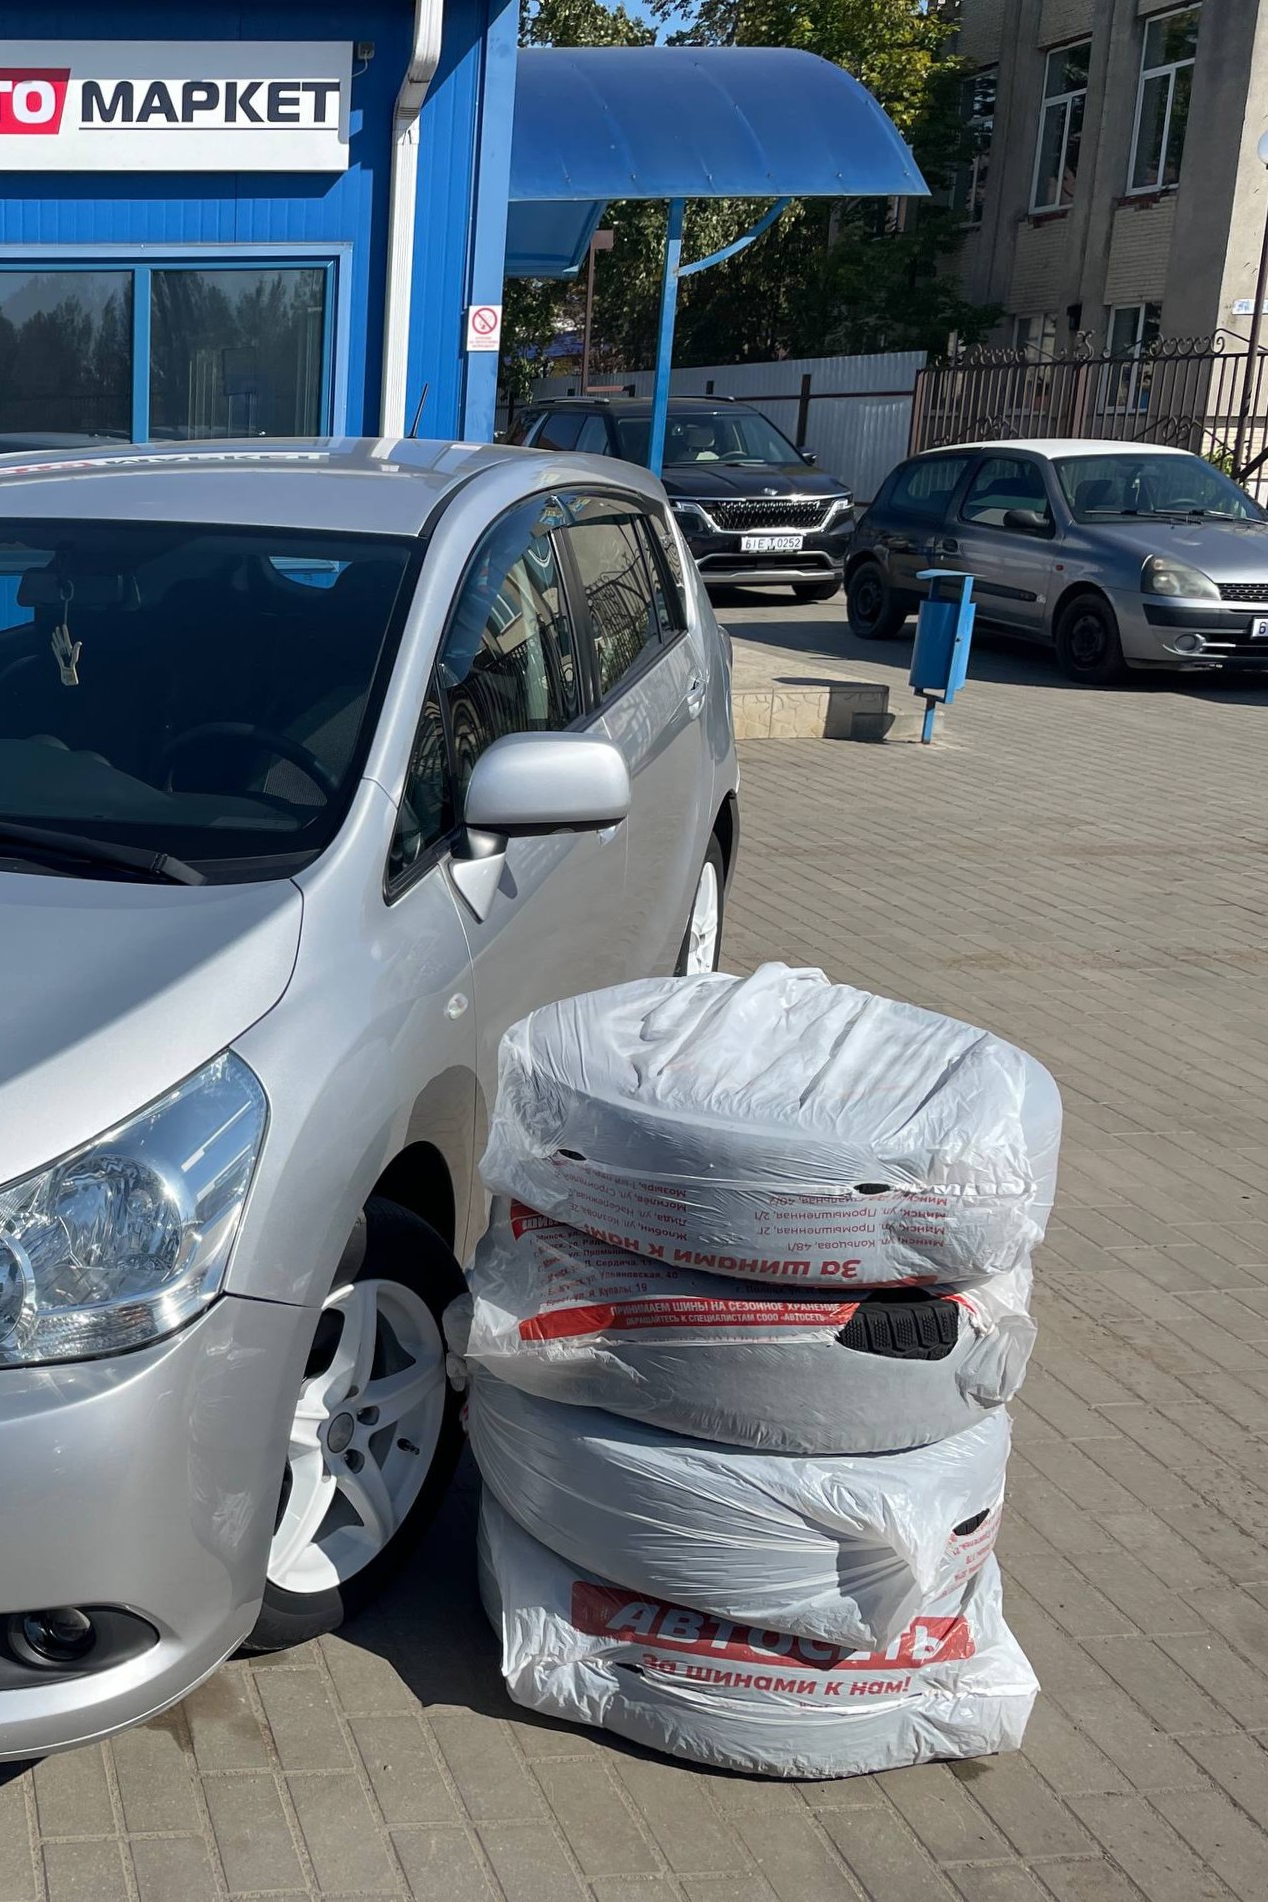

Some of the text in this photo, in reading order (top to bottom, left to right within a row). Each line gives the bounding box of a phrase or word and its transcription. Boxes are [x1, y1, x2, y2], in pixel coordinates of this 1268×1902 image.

[81, 80, 340, 124] МАРКЕТ
[639, 1182, 687, 1198] Мозырь,
[654, 1213, 687, 1226] Лида,
[773, 1207, 877, 1220] Промышленная,
[638, 1222, 687, 1241] Жлобин,
[773, 1223, 875, 1235] Промышленная,
[648, 1243, 664, 1258] к
[787, 1242, 812, 1252] 48/1
[815, 1240, 875, 1249] Кольцова,
[674, 1248, 811, 1278] шинами
[820, 1260, 861, 1279] За
[610, 1301, 840, 1316] ПРИНИМАЕМ ШИНЫ НА СЕЗОННОЕ ХРАНЕНИЕ
[626, 1314, 680, 1325] ОБРАЩАЙТЕСЬ
[681, 1314, 688, 1323] К
[688, 1312, 755, 1324] СПЕЦИАЛИСТАМ
[685, 1666, 817, 1696] шинами
[824, 1679, 841, 1696] к
[849, 1676, 912, 1696] нам!
